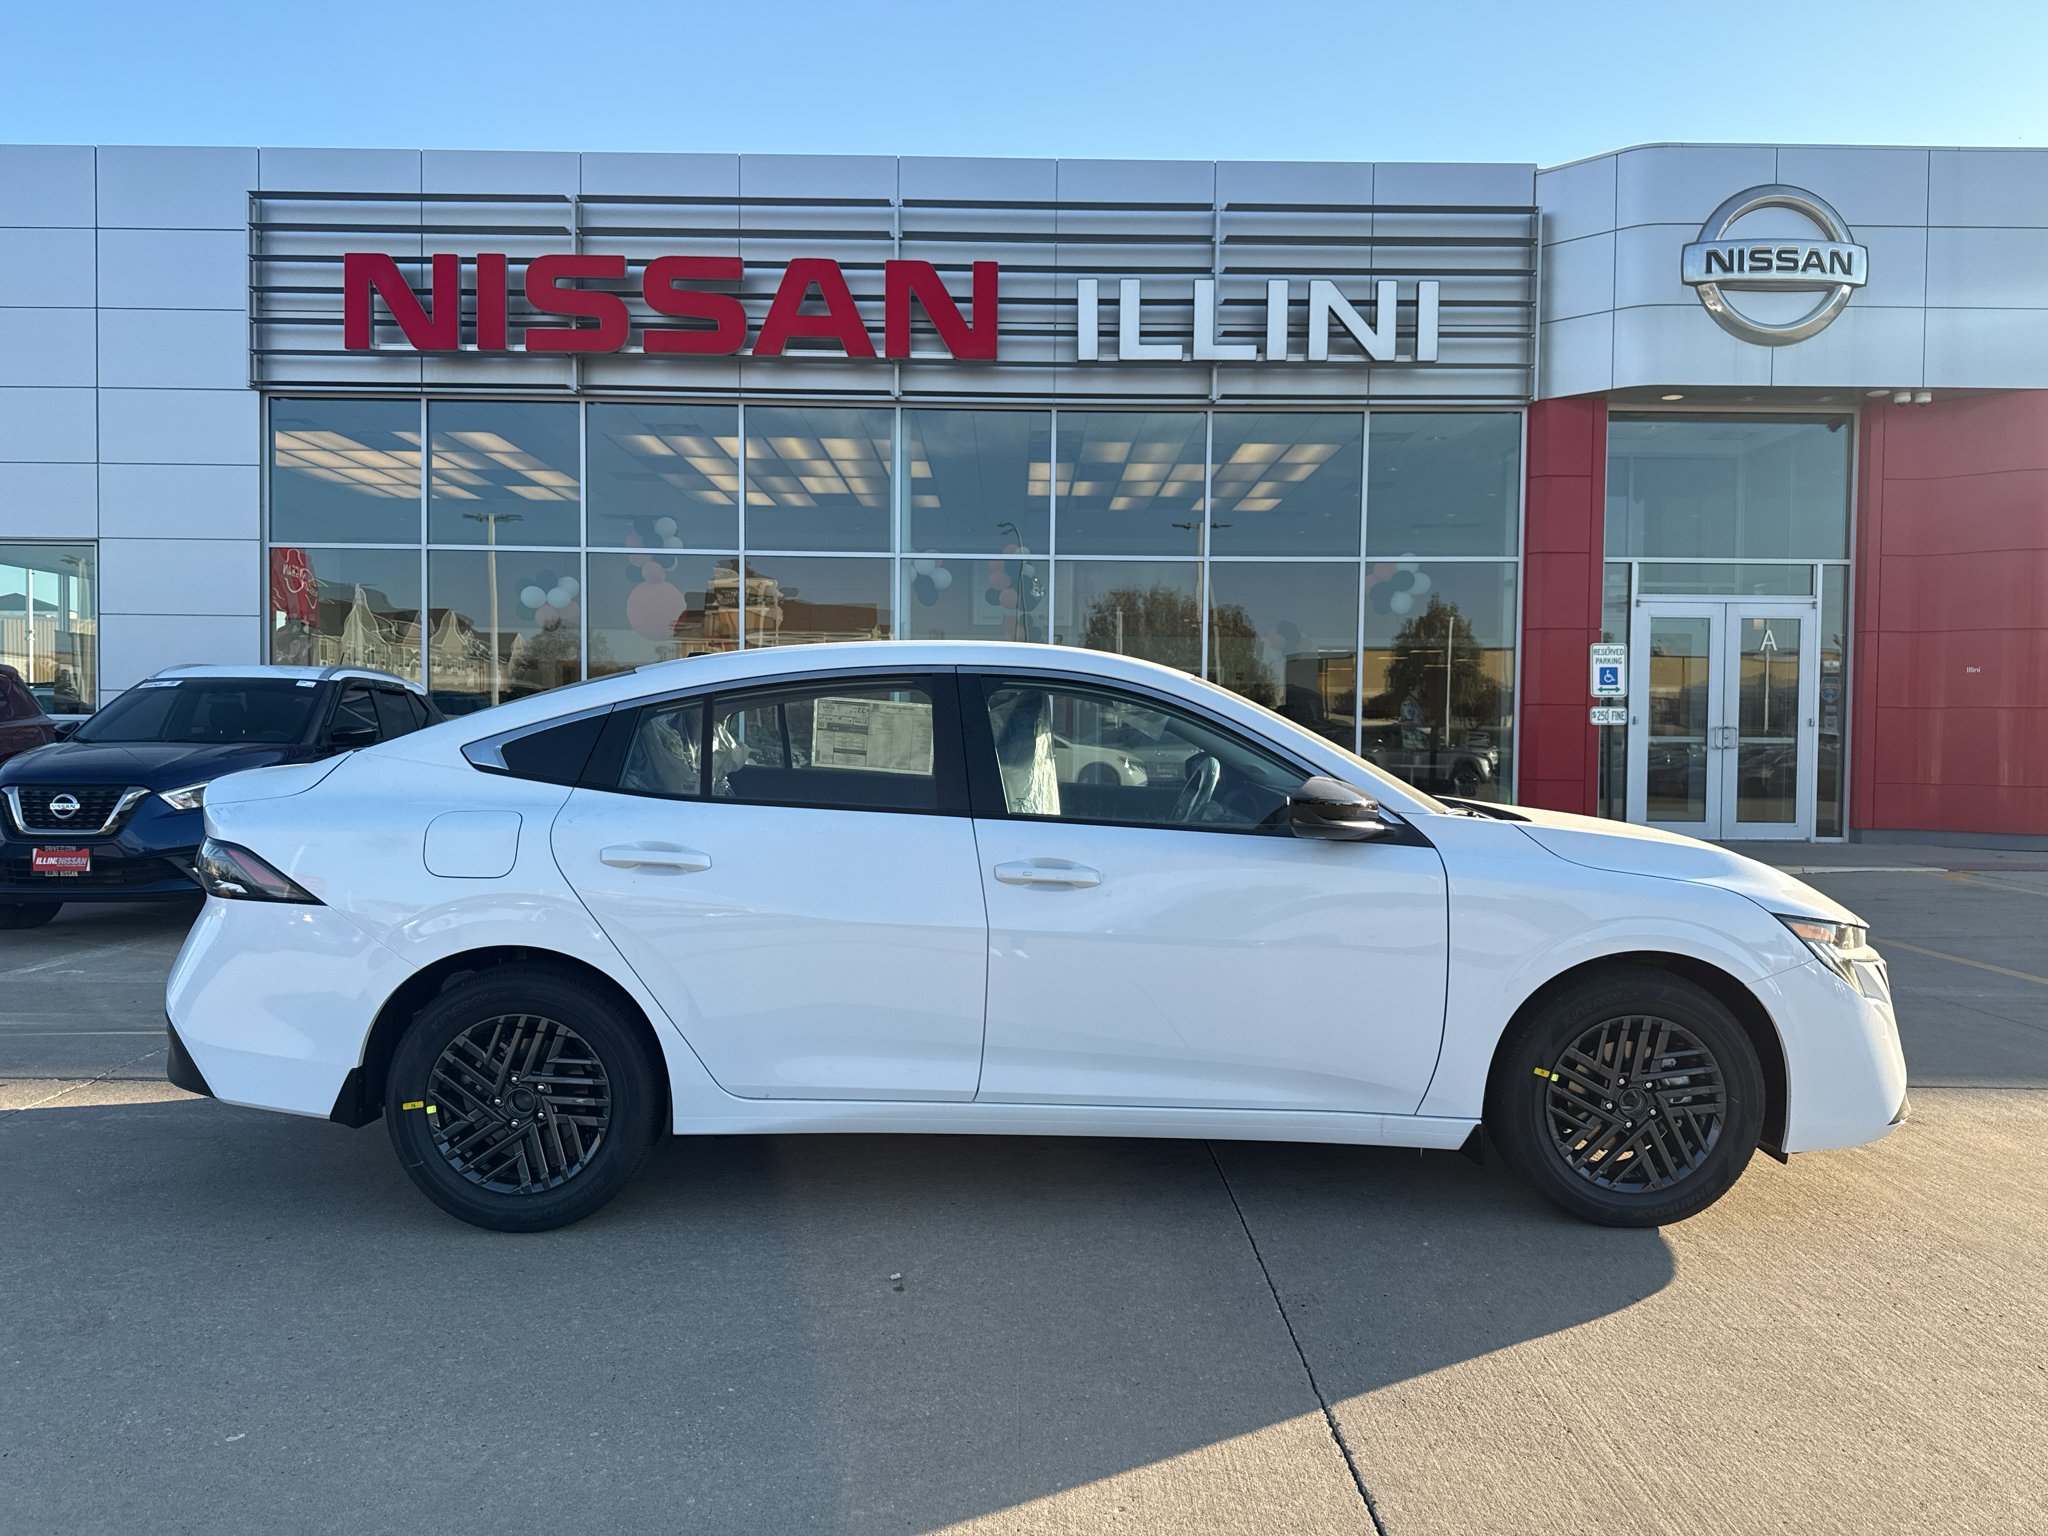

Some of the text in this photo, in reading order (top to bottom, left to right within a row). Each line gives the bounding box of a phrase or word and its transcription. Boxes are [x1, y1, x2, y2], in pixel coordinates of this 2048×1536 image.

[1705, 248, 1853, 276] NISSAN
[344, 253, 1440, 362] NISSAN ILLINI
[1760, 629, 1777, 651] A
[1593, 648, 1624, 656] RESERVED
[1595, 657, 1622, 665] PARKING
[1591, 710, 1626, 721] $250 FINE
